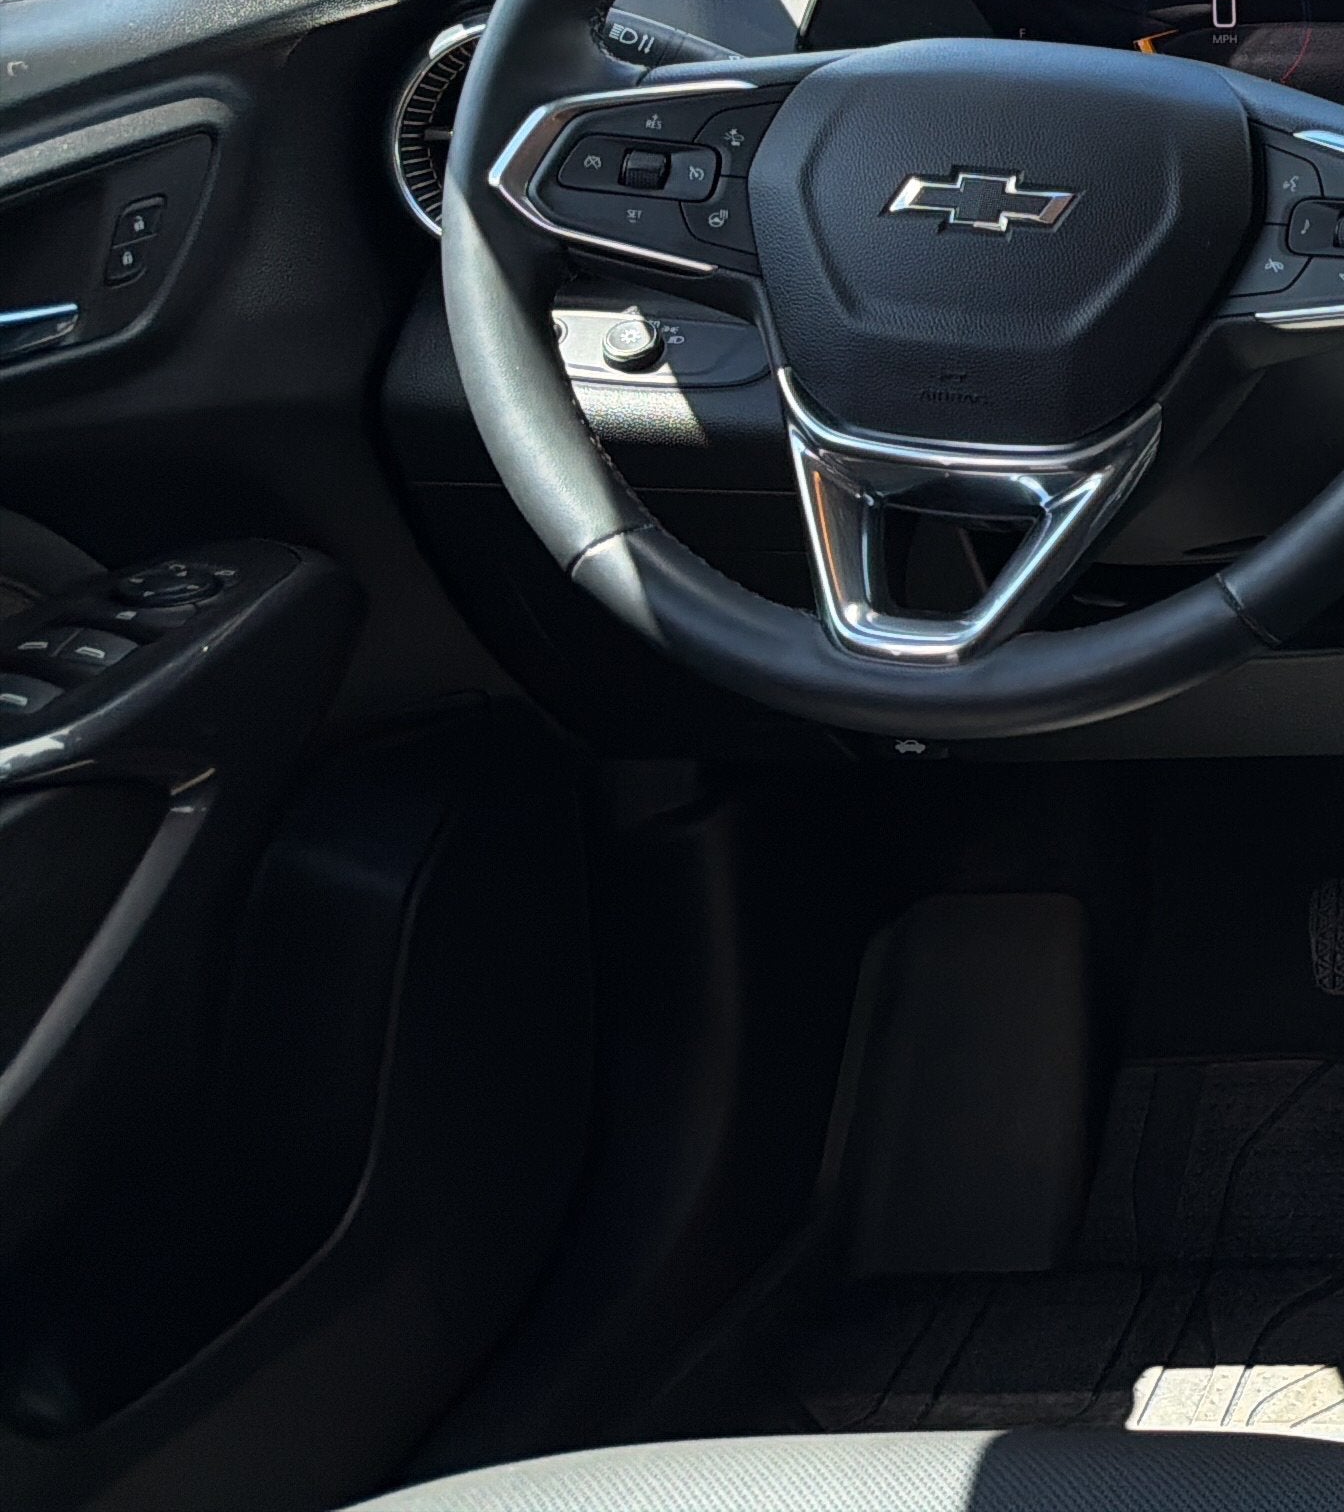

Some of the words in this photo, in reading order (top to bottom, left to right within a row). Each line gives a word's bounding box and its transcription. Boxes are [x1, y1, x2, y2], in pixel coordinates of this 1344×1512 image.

[1019, 28, 1027, 39] F
[1212, 34, 1238, 44] MPH
[645, 119, 662, 130] RES
[626, 209, 643, 219] SET
